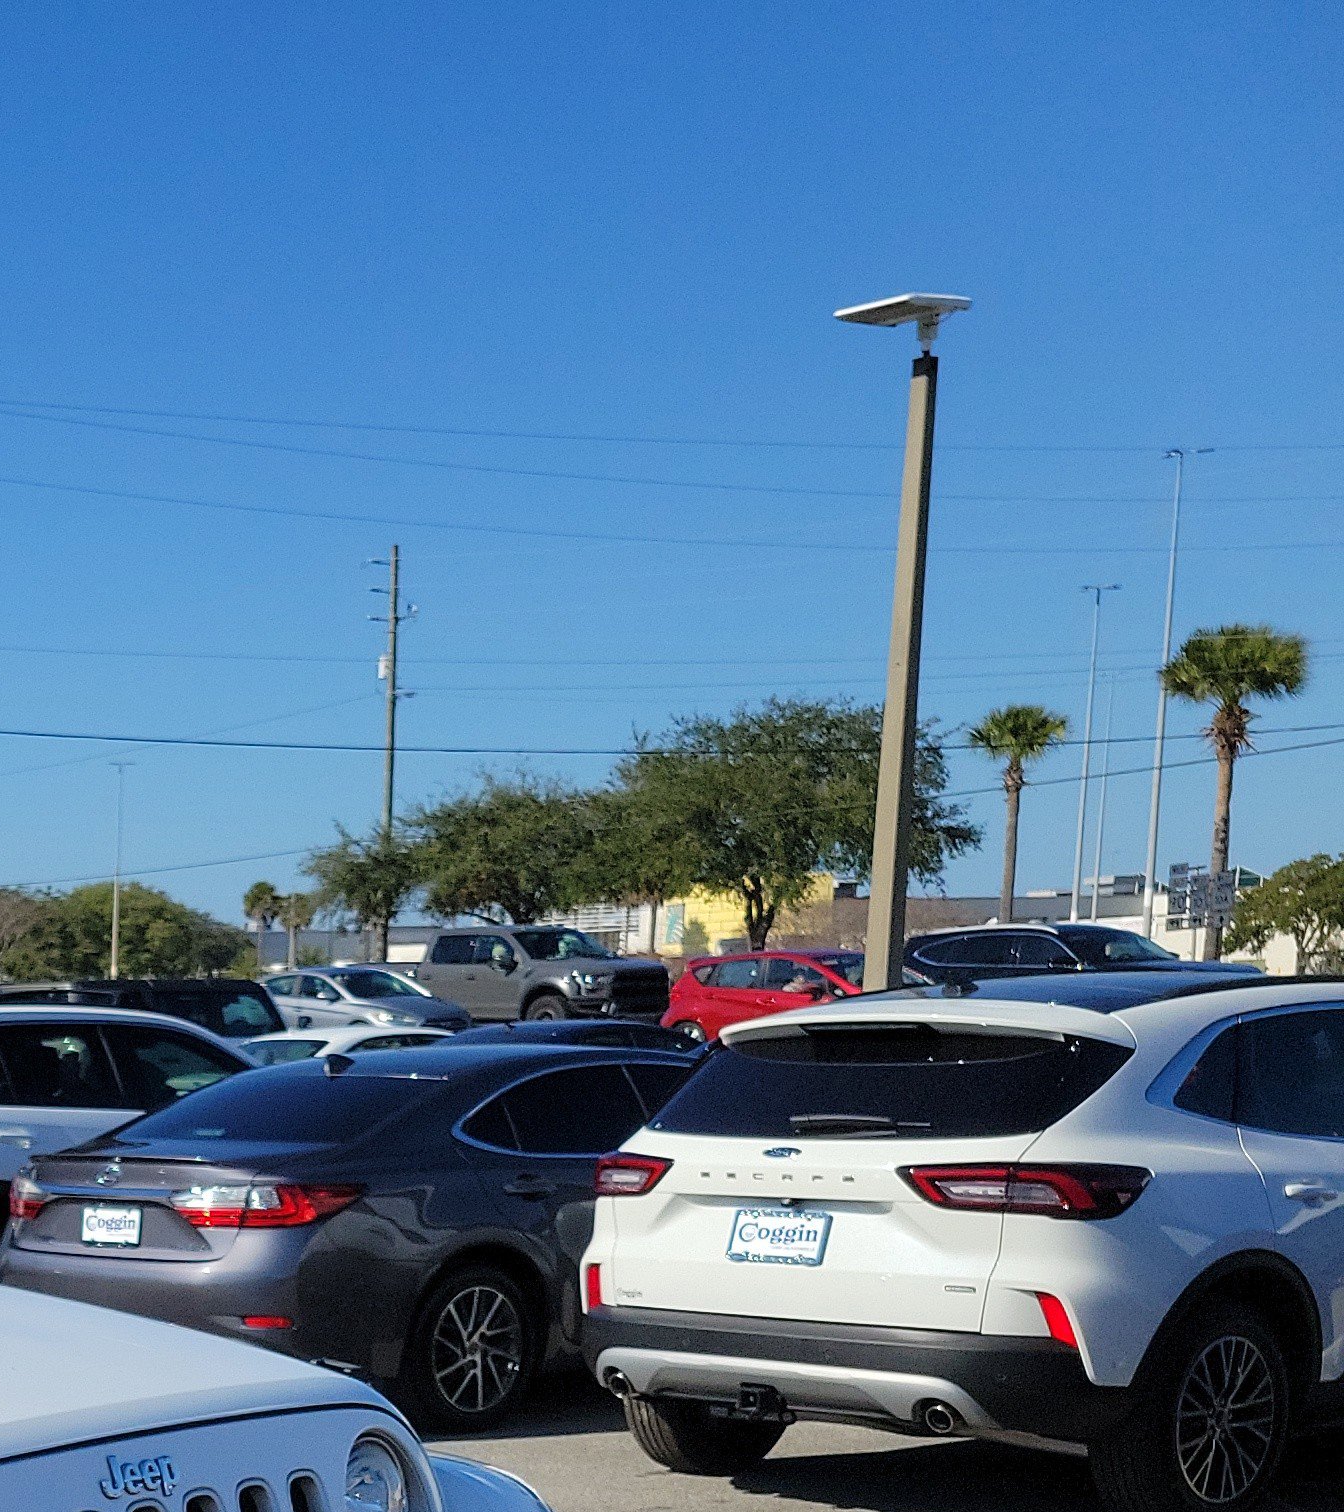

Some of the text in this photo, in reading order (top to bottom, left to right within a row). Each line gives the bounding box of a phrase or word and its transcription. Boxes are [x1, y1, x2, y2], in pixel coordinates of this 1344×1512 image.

[86, 1214, 136, 1232] Coggin
[738, 1222, 818, 1245] Coggin
[99, 1454, 180, 1500] Jeep
